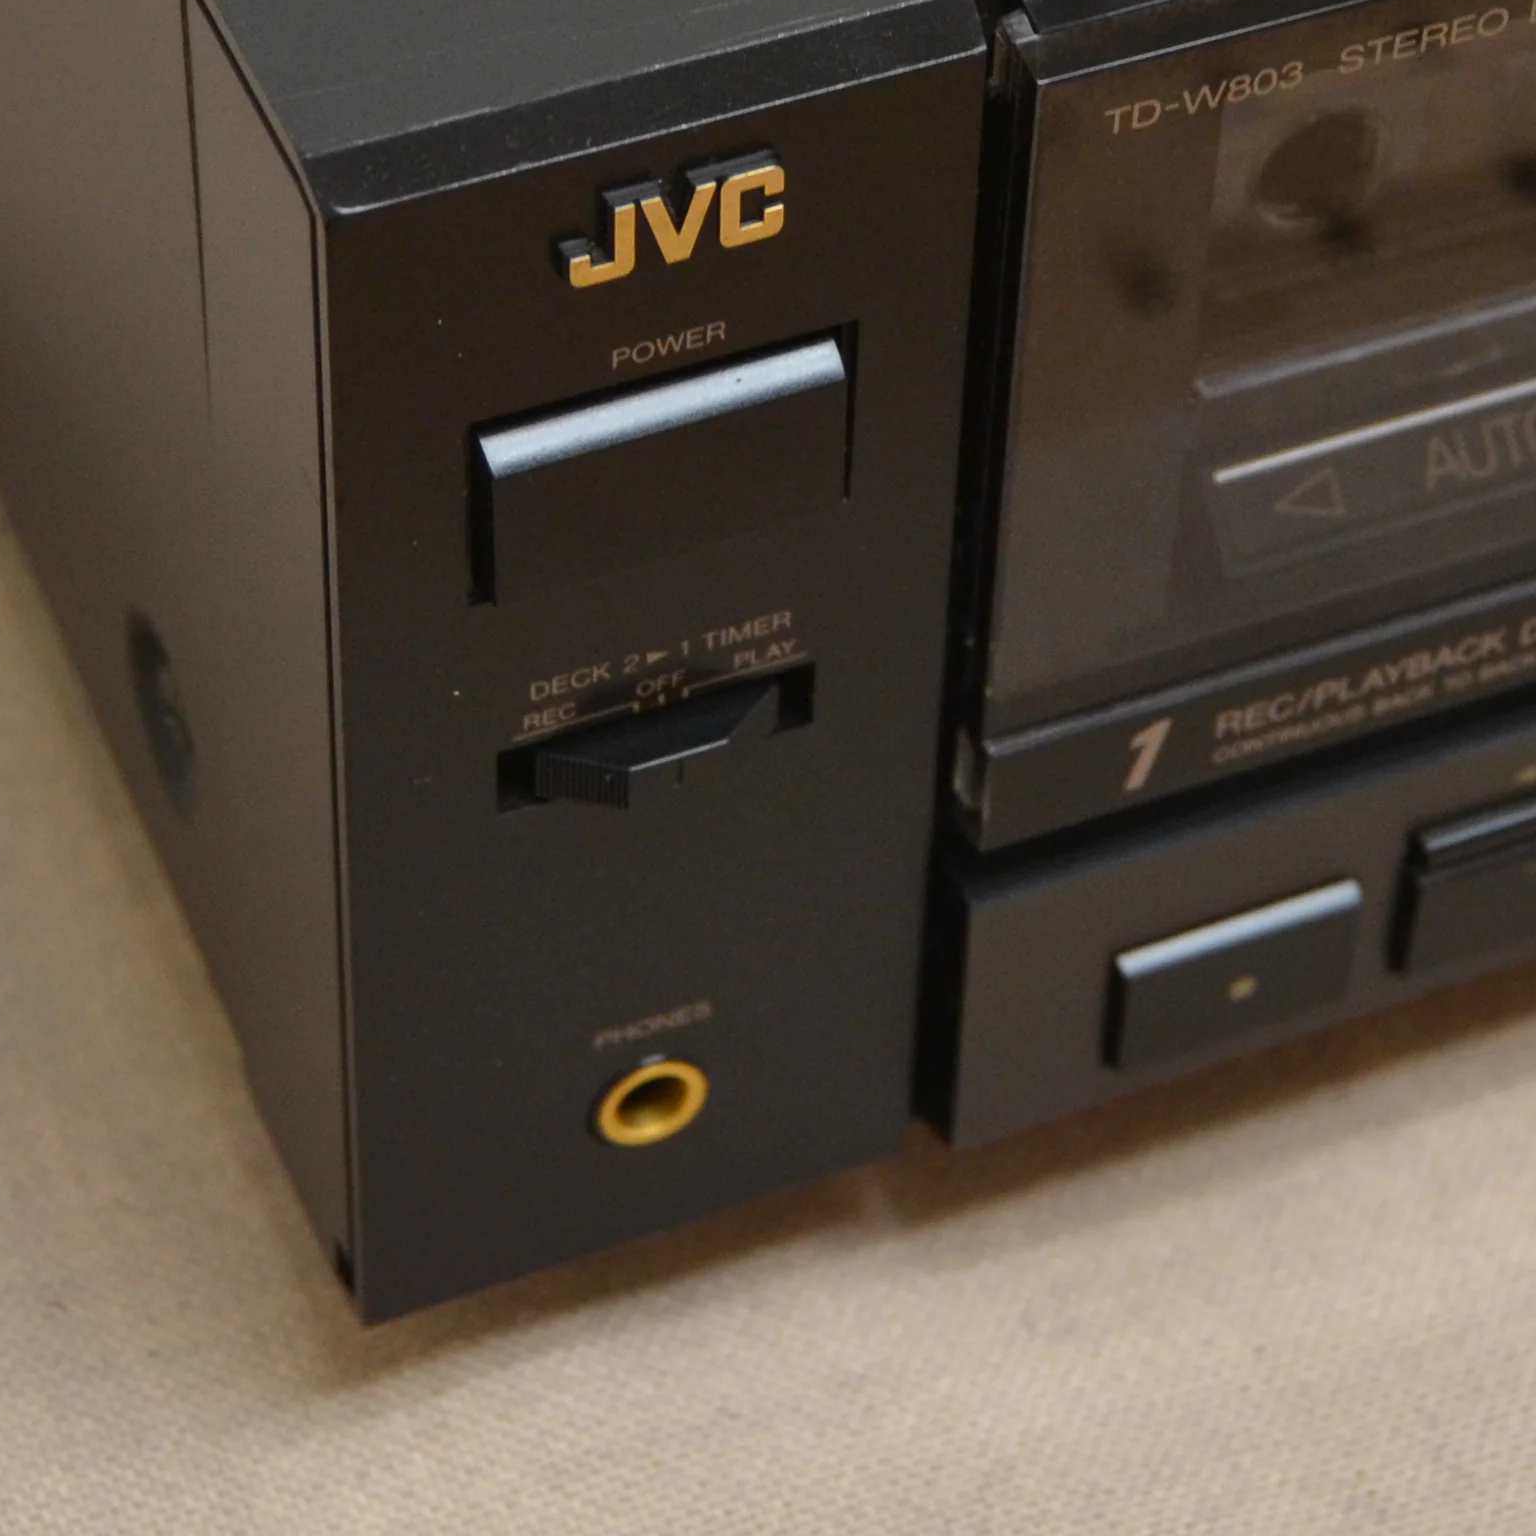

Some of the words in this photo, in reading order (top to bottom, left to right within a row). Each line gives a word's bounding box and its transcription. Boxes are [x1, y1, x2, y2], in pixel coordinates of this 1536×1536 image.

[1105, 61, 1304, 135] TD-W803
[1338, 8, 1509, 75] STEREO
[567, 163, 786, 289] JVC
[611, 320, 727, 370] POWER
[529, 661, 612, 702] DECK
[622, 653, 641, 674] 2
[680, 638, 691, 657] 1
[702, 609, 794, 652] TIMER
[635, 669, 687, 698] OFF
[732, 638, 797, 669] PLAY
[1213, 627, 1508, 740] REC/PLAYBACK
[523, 703, 577, 732] REC
[1122, 716, 1173, 793] 1
